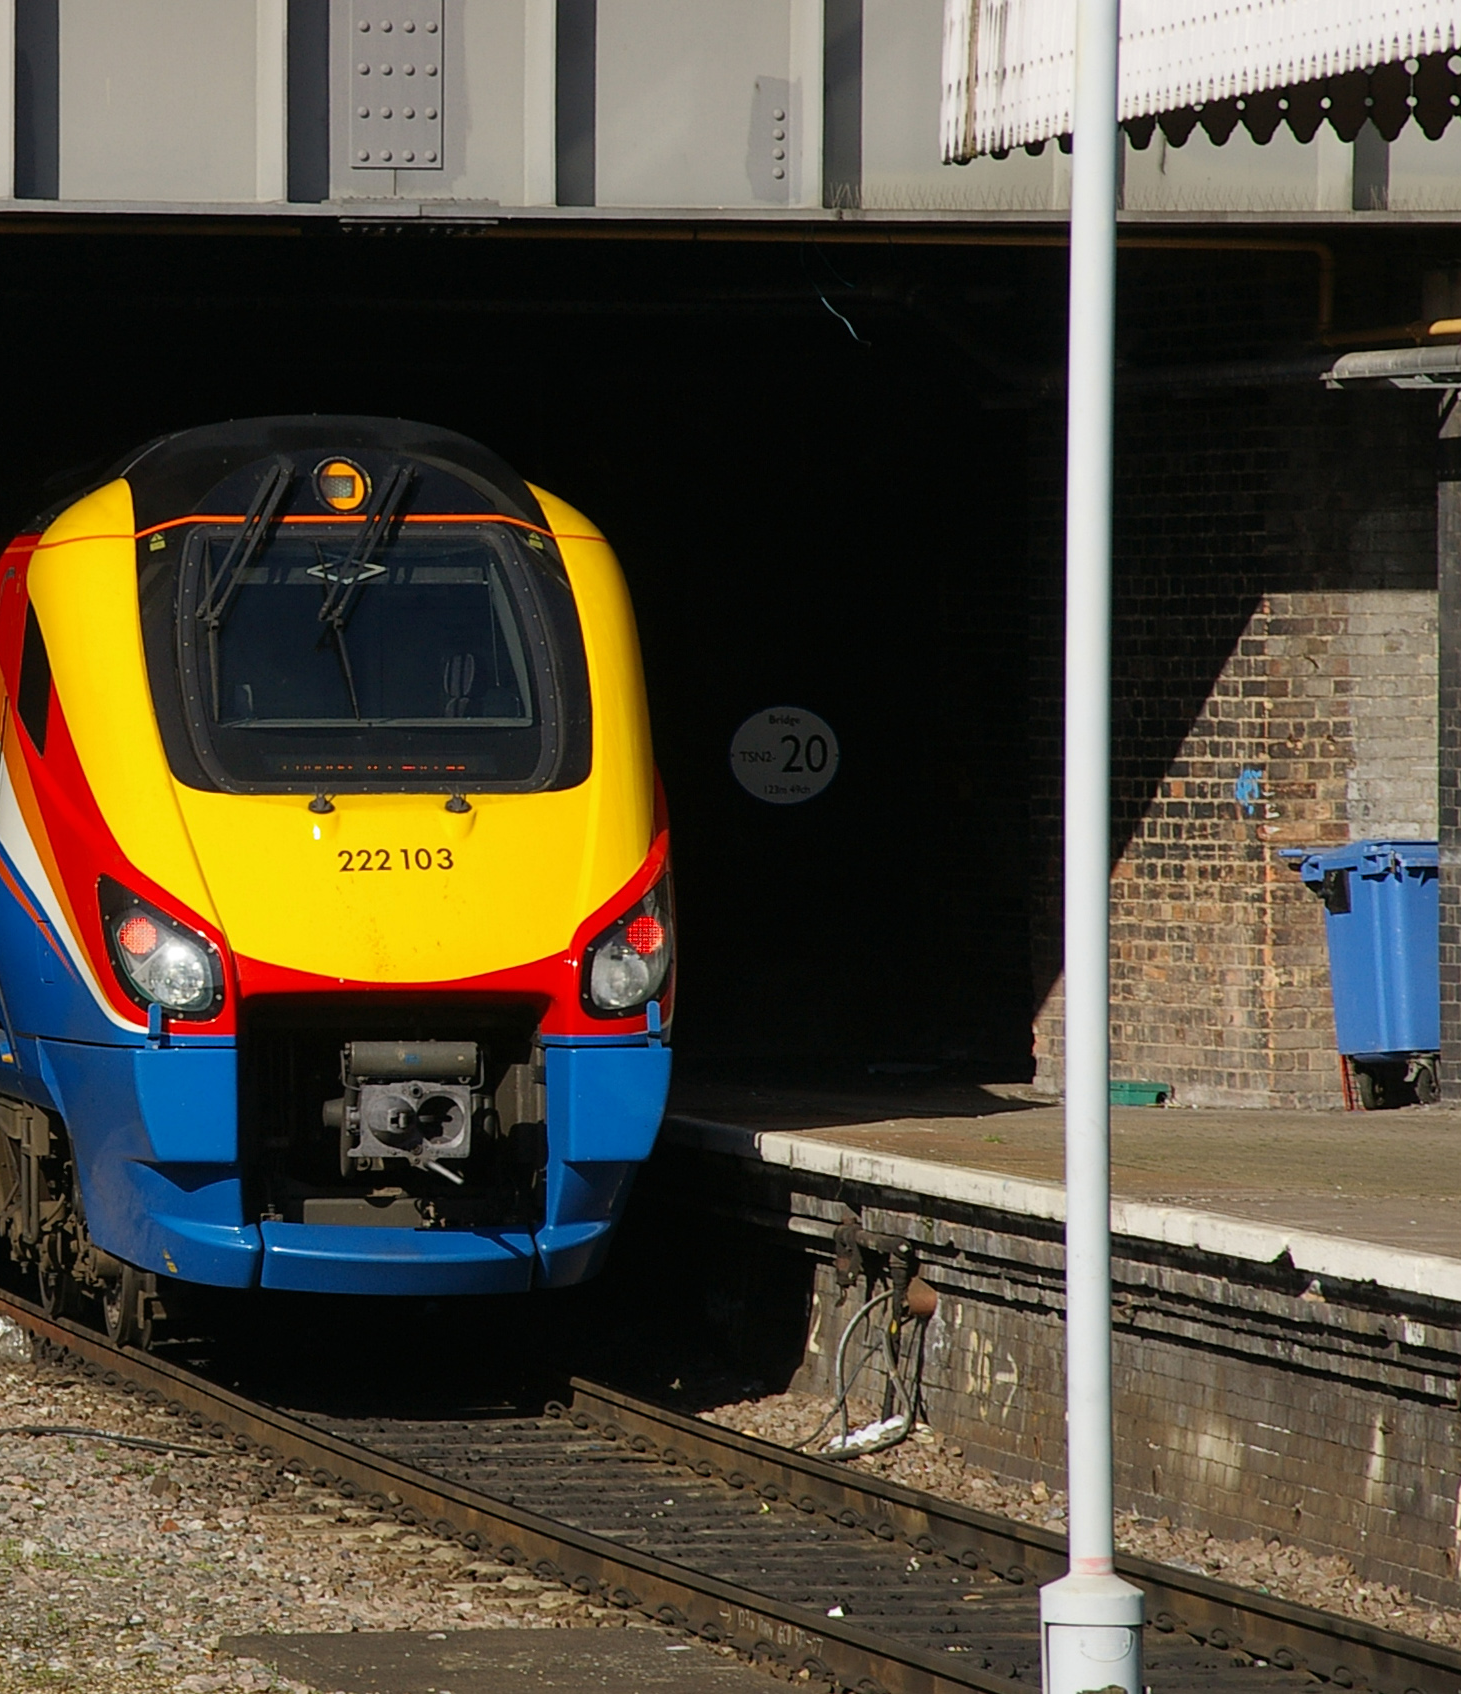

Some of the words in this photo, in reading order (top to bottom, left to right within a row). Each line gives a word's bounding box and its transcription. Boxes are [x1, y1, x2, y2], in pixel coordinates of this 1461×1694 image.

[769, 715, 801, 727] Bridge
[781, 734, 828, 773] 20
[337, 849, 392, 873] 222
[400, 848, 454, 871] 103
